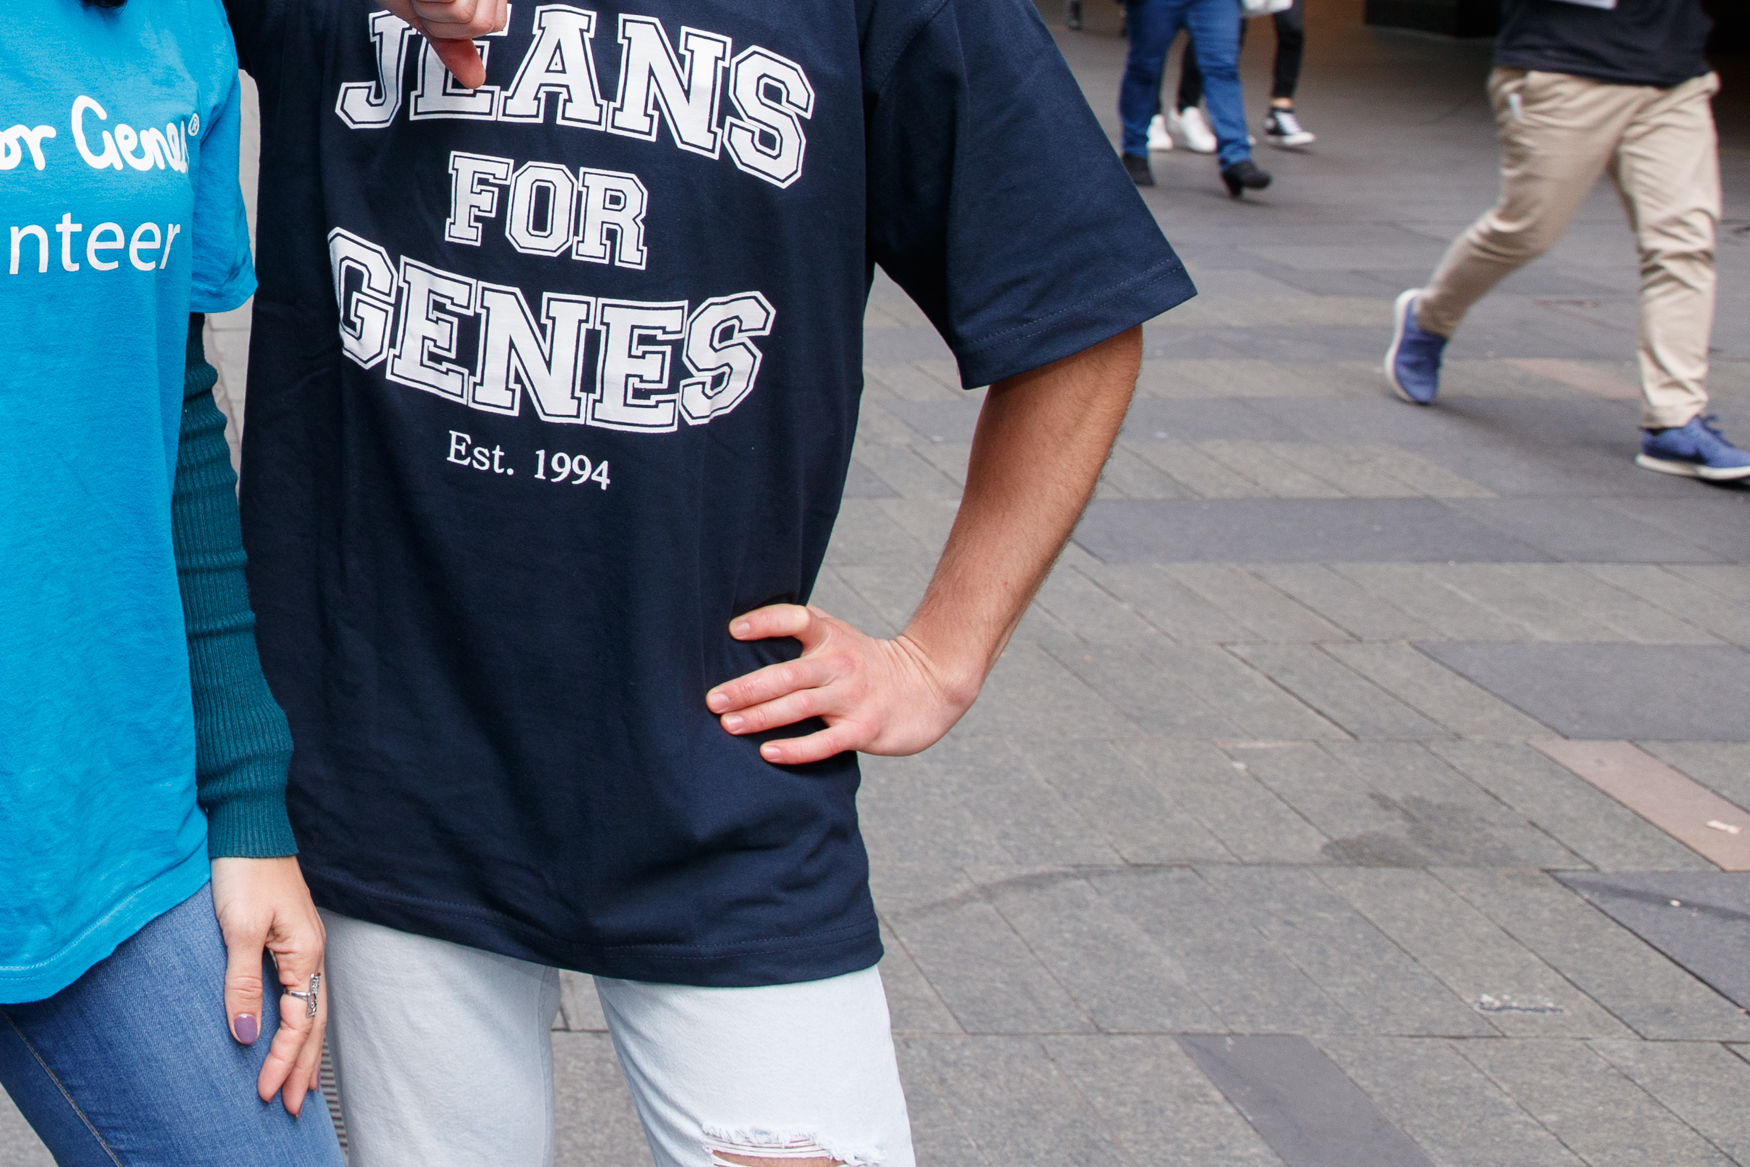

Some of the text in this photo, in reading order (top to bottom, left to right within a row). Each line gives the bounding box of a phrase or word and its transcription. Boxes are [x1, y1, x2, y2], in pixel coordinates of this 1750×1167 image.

[445, 150, 648, 270] FOR
[327, 226, 776, 433] GENES
[446, 430, 611, 491] Est. 1994
